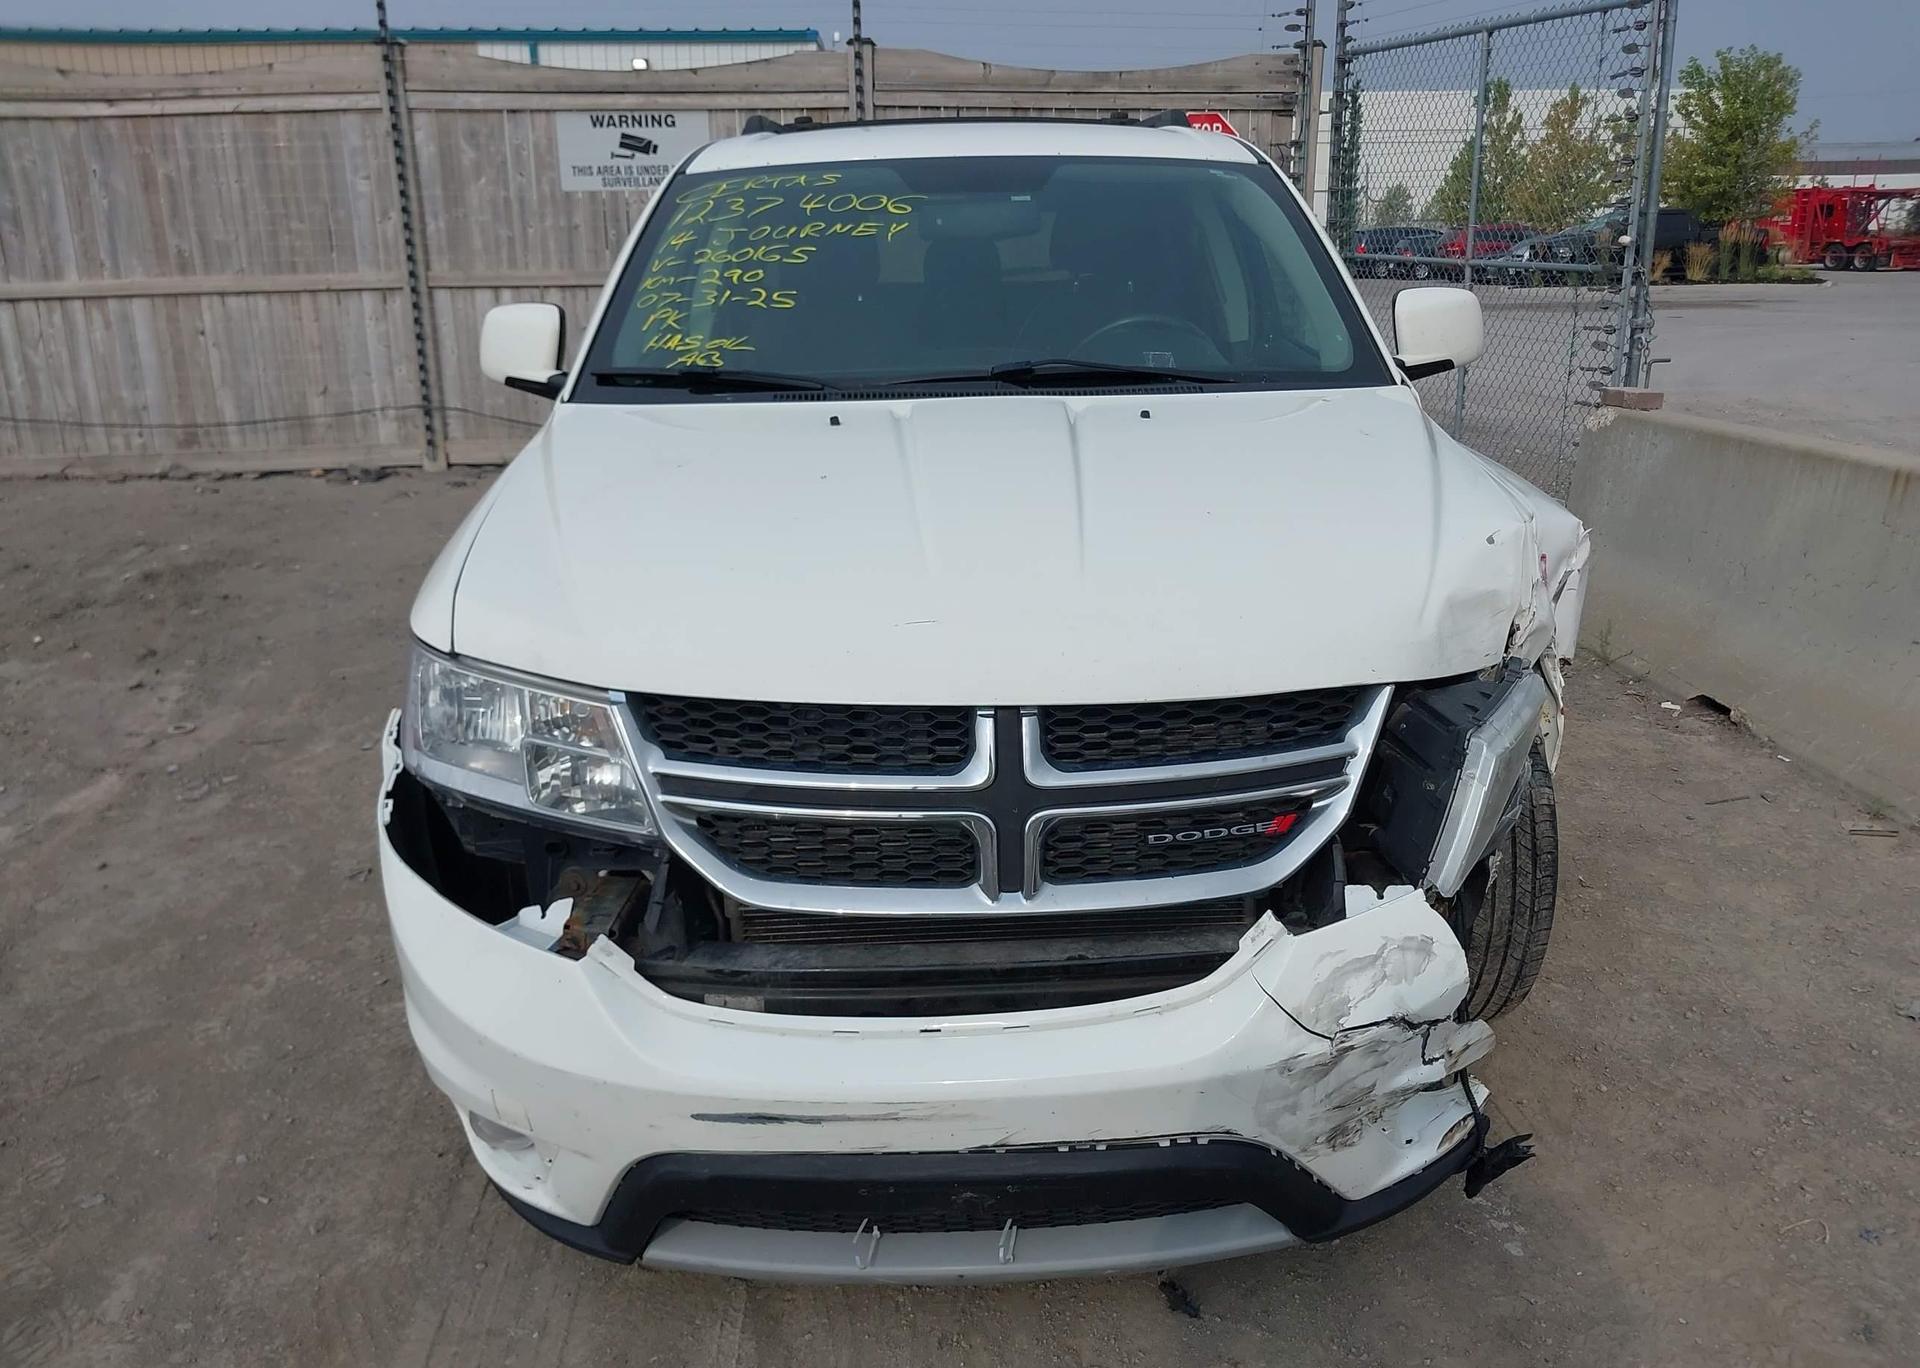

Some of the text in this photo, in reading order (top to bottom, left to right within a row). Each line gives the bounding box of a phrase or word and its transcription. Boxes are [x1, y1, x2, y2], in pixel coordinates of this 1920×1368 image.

[590, 114, 676, 128] WARNING
[572, 165, 593, 177] THIS
[596, 165, 620, 176] AREA
[624, 165, 634, 176] IS
[636, 164, 669, 176] UNDER
[601, 176, 664, 188] SURVEILLAN
[717, 222, 909, 243] JOURNEY
[1148, 819, 1279, 845] DODGE
